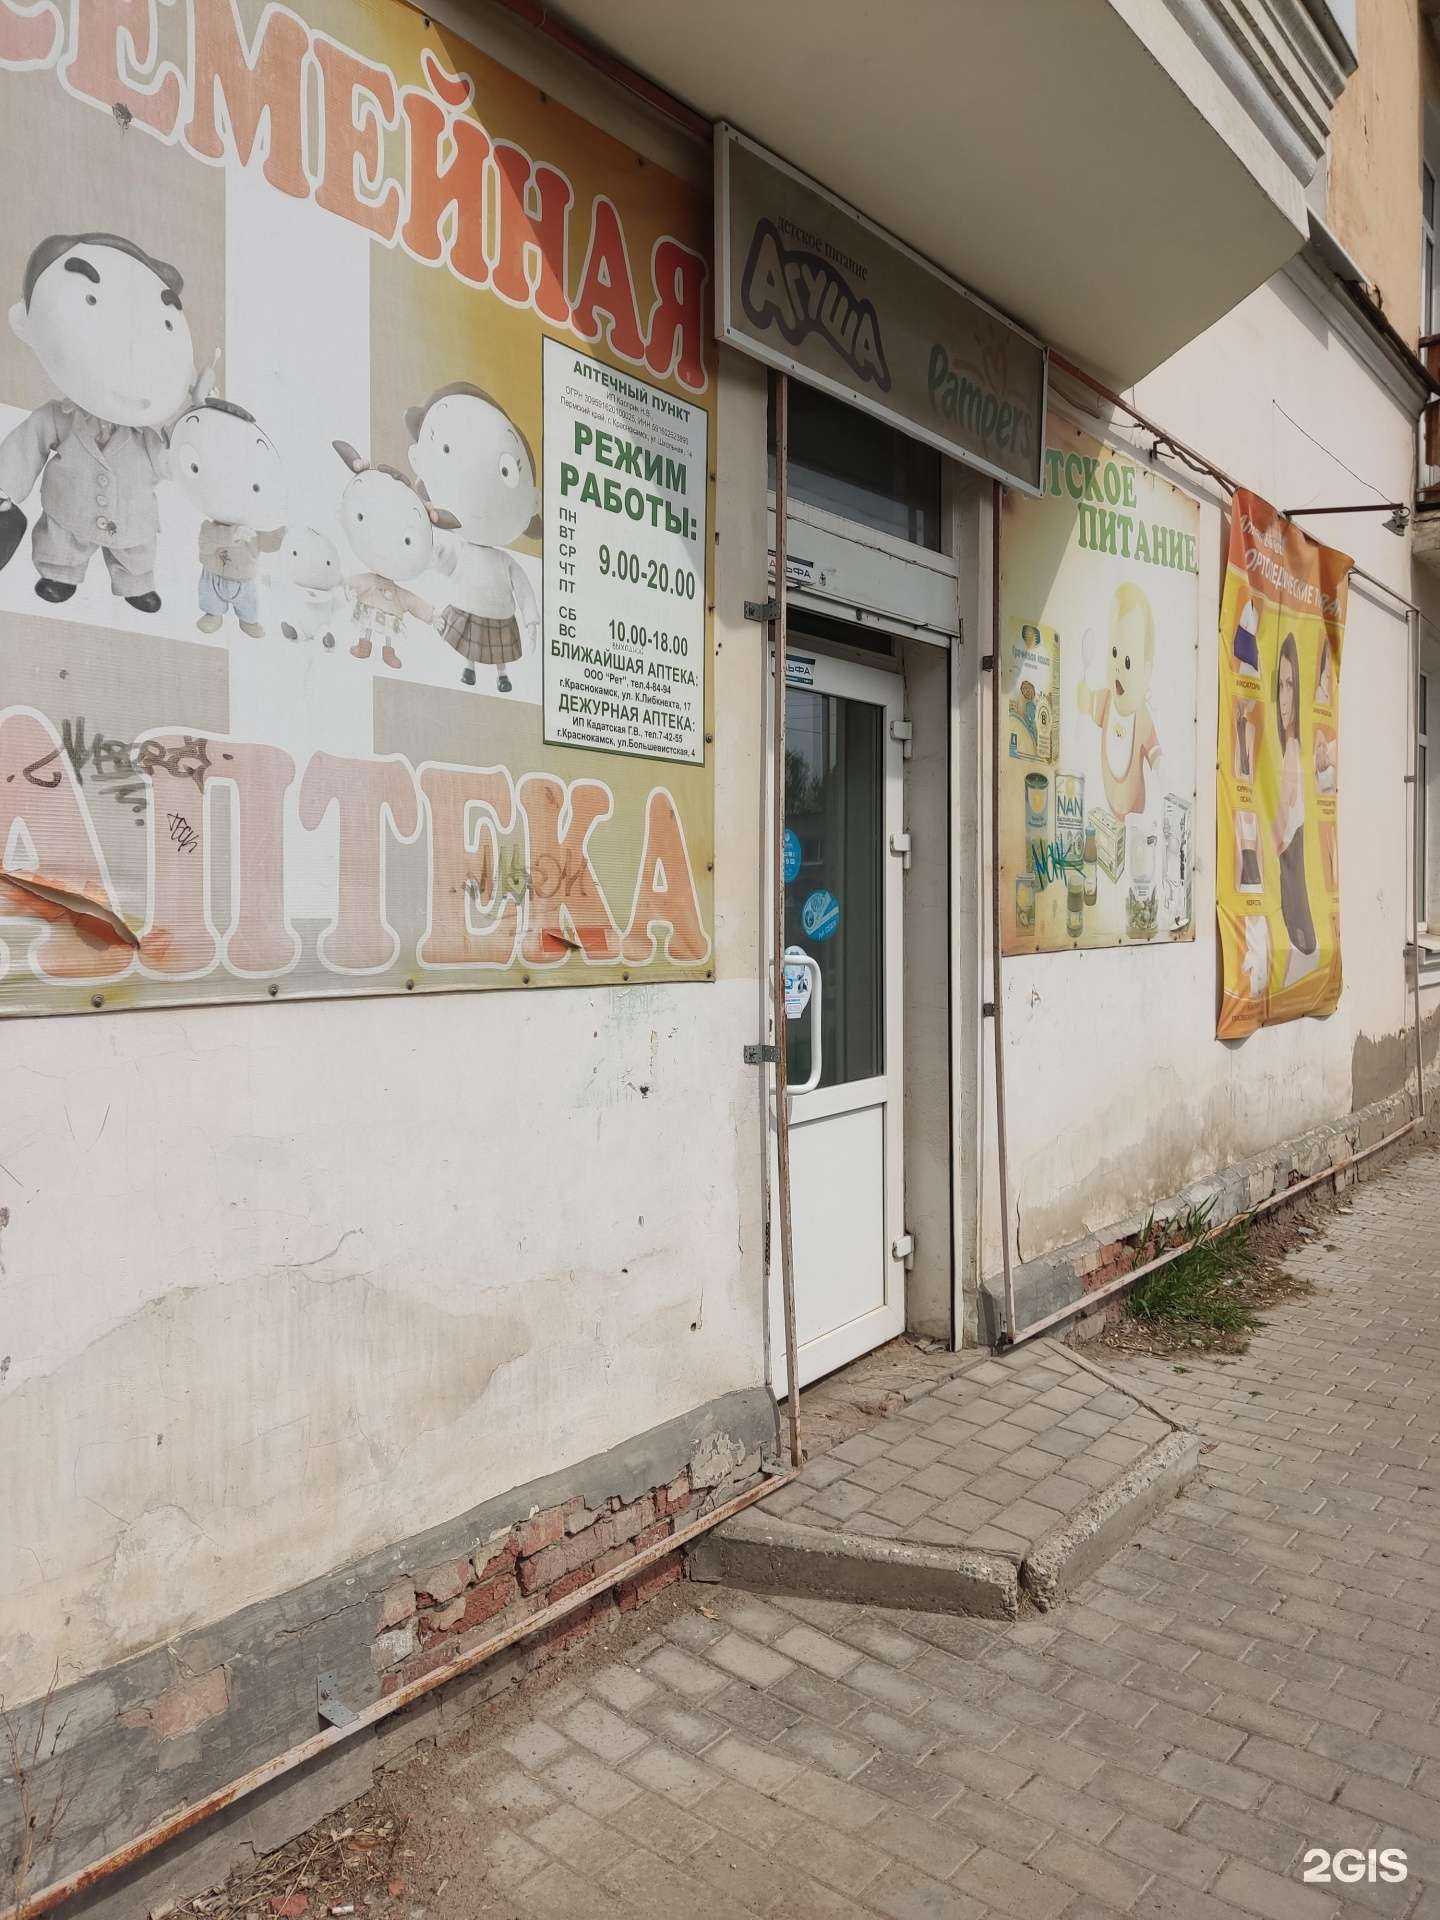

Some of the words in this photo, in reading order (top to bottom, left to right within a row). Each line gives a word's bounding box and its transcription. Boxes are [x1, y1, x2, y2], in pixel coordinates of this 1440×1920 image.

[573, 360, 649, 404] АПТЕЧНЫЙ
[652, 394, 690, 423] ПУНКТ
[574, 420, 687, 495] РЕЖИМ
[1046, 449, 1137, 508] ТСКОЕ
[559, 507, 577, 523] ПН
[560, 461, 697, 541] РАБОТЫ:
[559, 525, 575, 541] ВТ
[1077, 502, 1199, 573] ПИТАНИЕ
[559, 560, 575, 576] ЧТ
[559, 543, 577, 558] СР
[599, 544, 695, 600] 9.00-20.00
[559, 578, 575, 594] ПТ
[559, 605, 577, 621] СБ
[609, 619, 688, 656] 10.00-18.00
[559, 623, 577, 639] ВС
[551, 639, 644, 675] БЛИЖАЙШАЯ
[647, 659, 699, 687] АПТЕКА:
[584, 667, 604, 681] ООО
[559, 677, 620, 699] г.Краснокамск,
[684, 701, 691, 711] 17
[559, 692, 639, 723] ДЕЖУРНАЯ
[642, 709, 695, 733] АПТЕКА:
[557, 727, 616, 747] г.Краснокамск,
[572, 716, 585, 727] ИП
[586, 719, 626, 735] Кадатская
[1057, 794, 1083, 817] NAN
[0, 704, 711, 980] АПТЕКА
